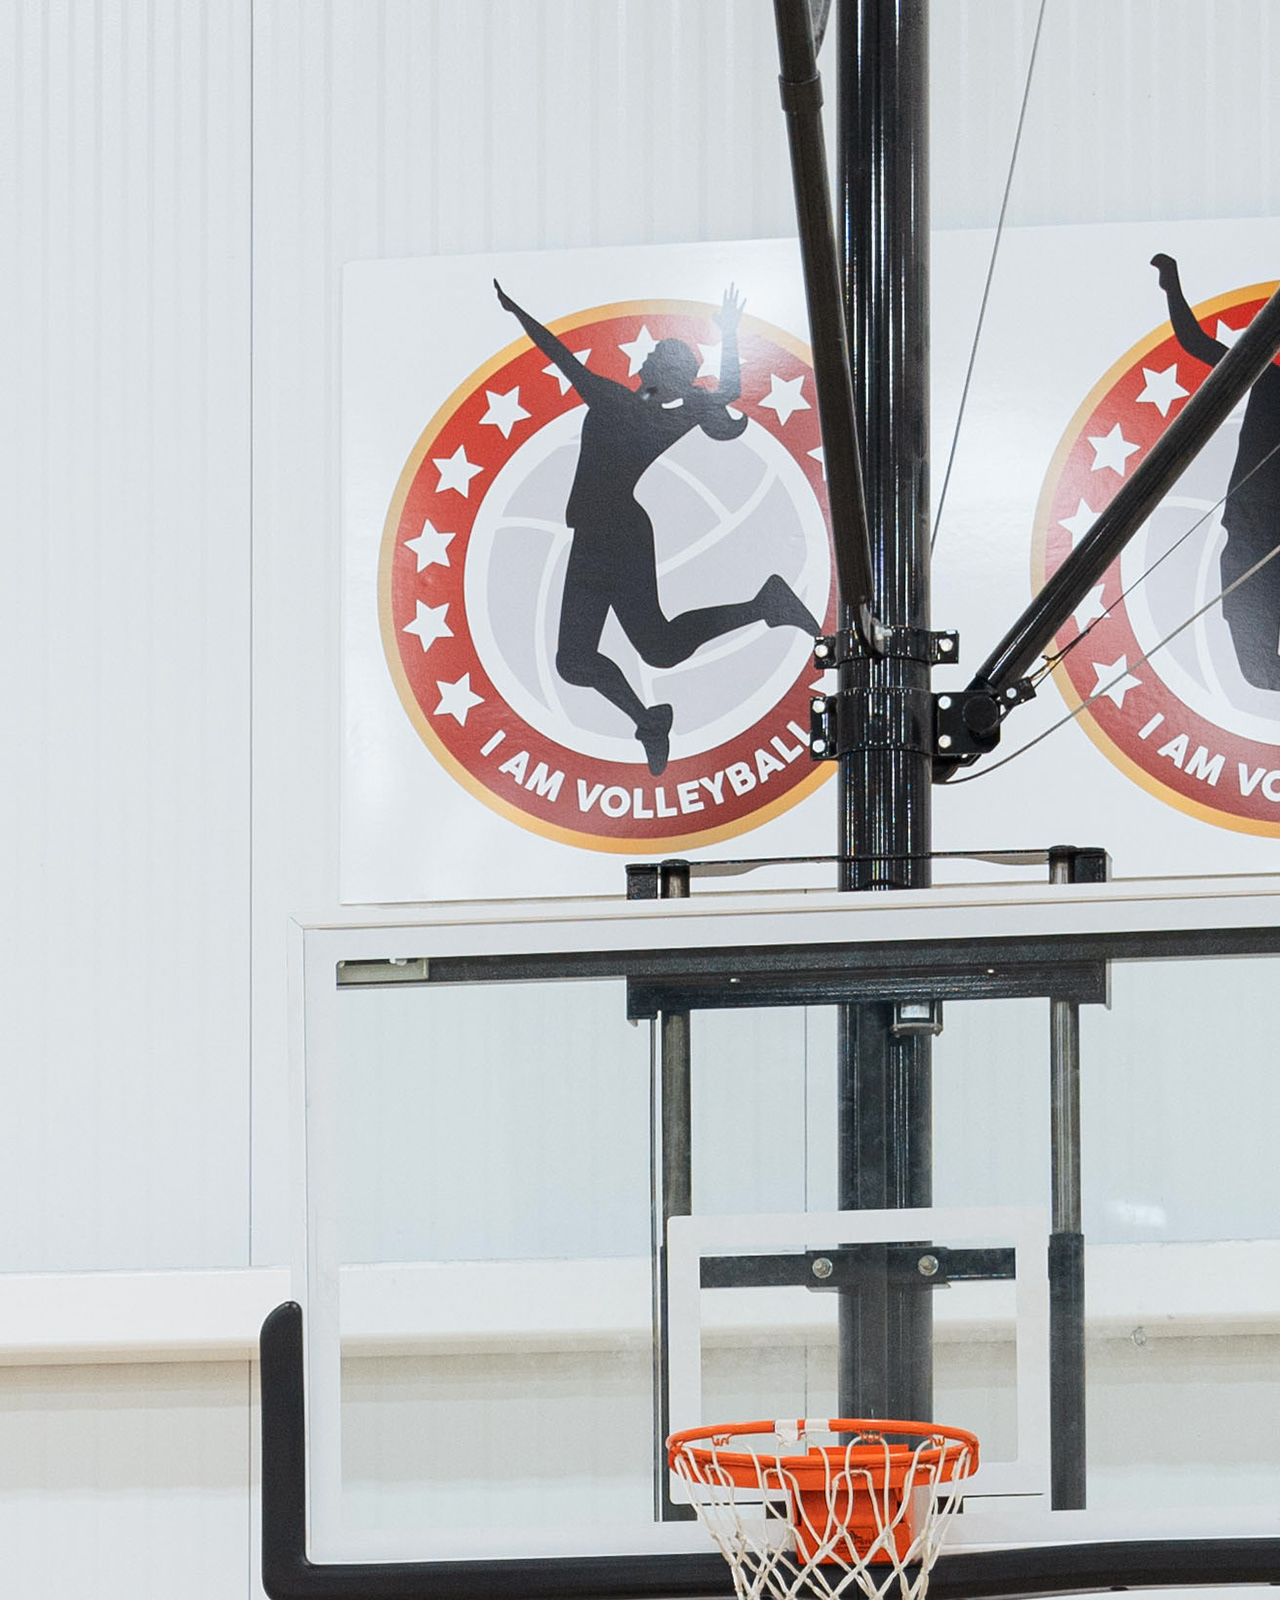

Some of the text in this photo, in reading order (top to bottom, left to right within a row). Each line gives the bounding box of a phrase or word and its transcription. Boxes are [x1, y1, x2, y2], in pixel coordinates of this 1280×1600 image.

[480, 720, 811, 819] I AM VOLLEYBALL
[1138, 712, 1165, 740] I
[1157, 733, 1226, 787] AM
